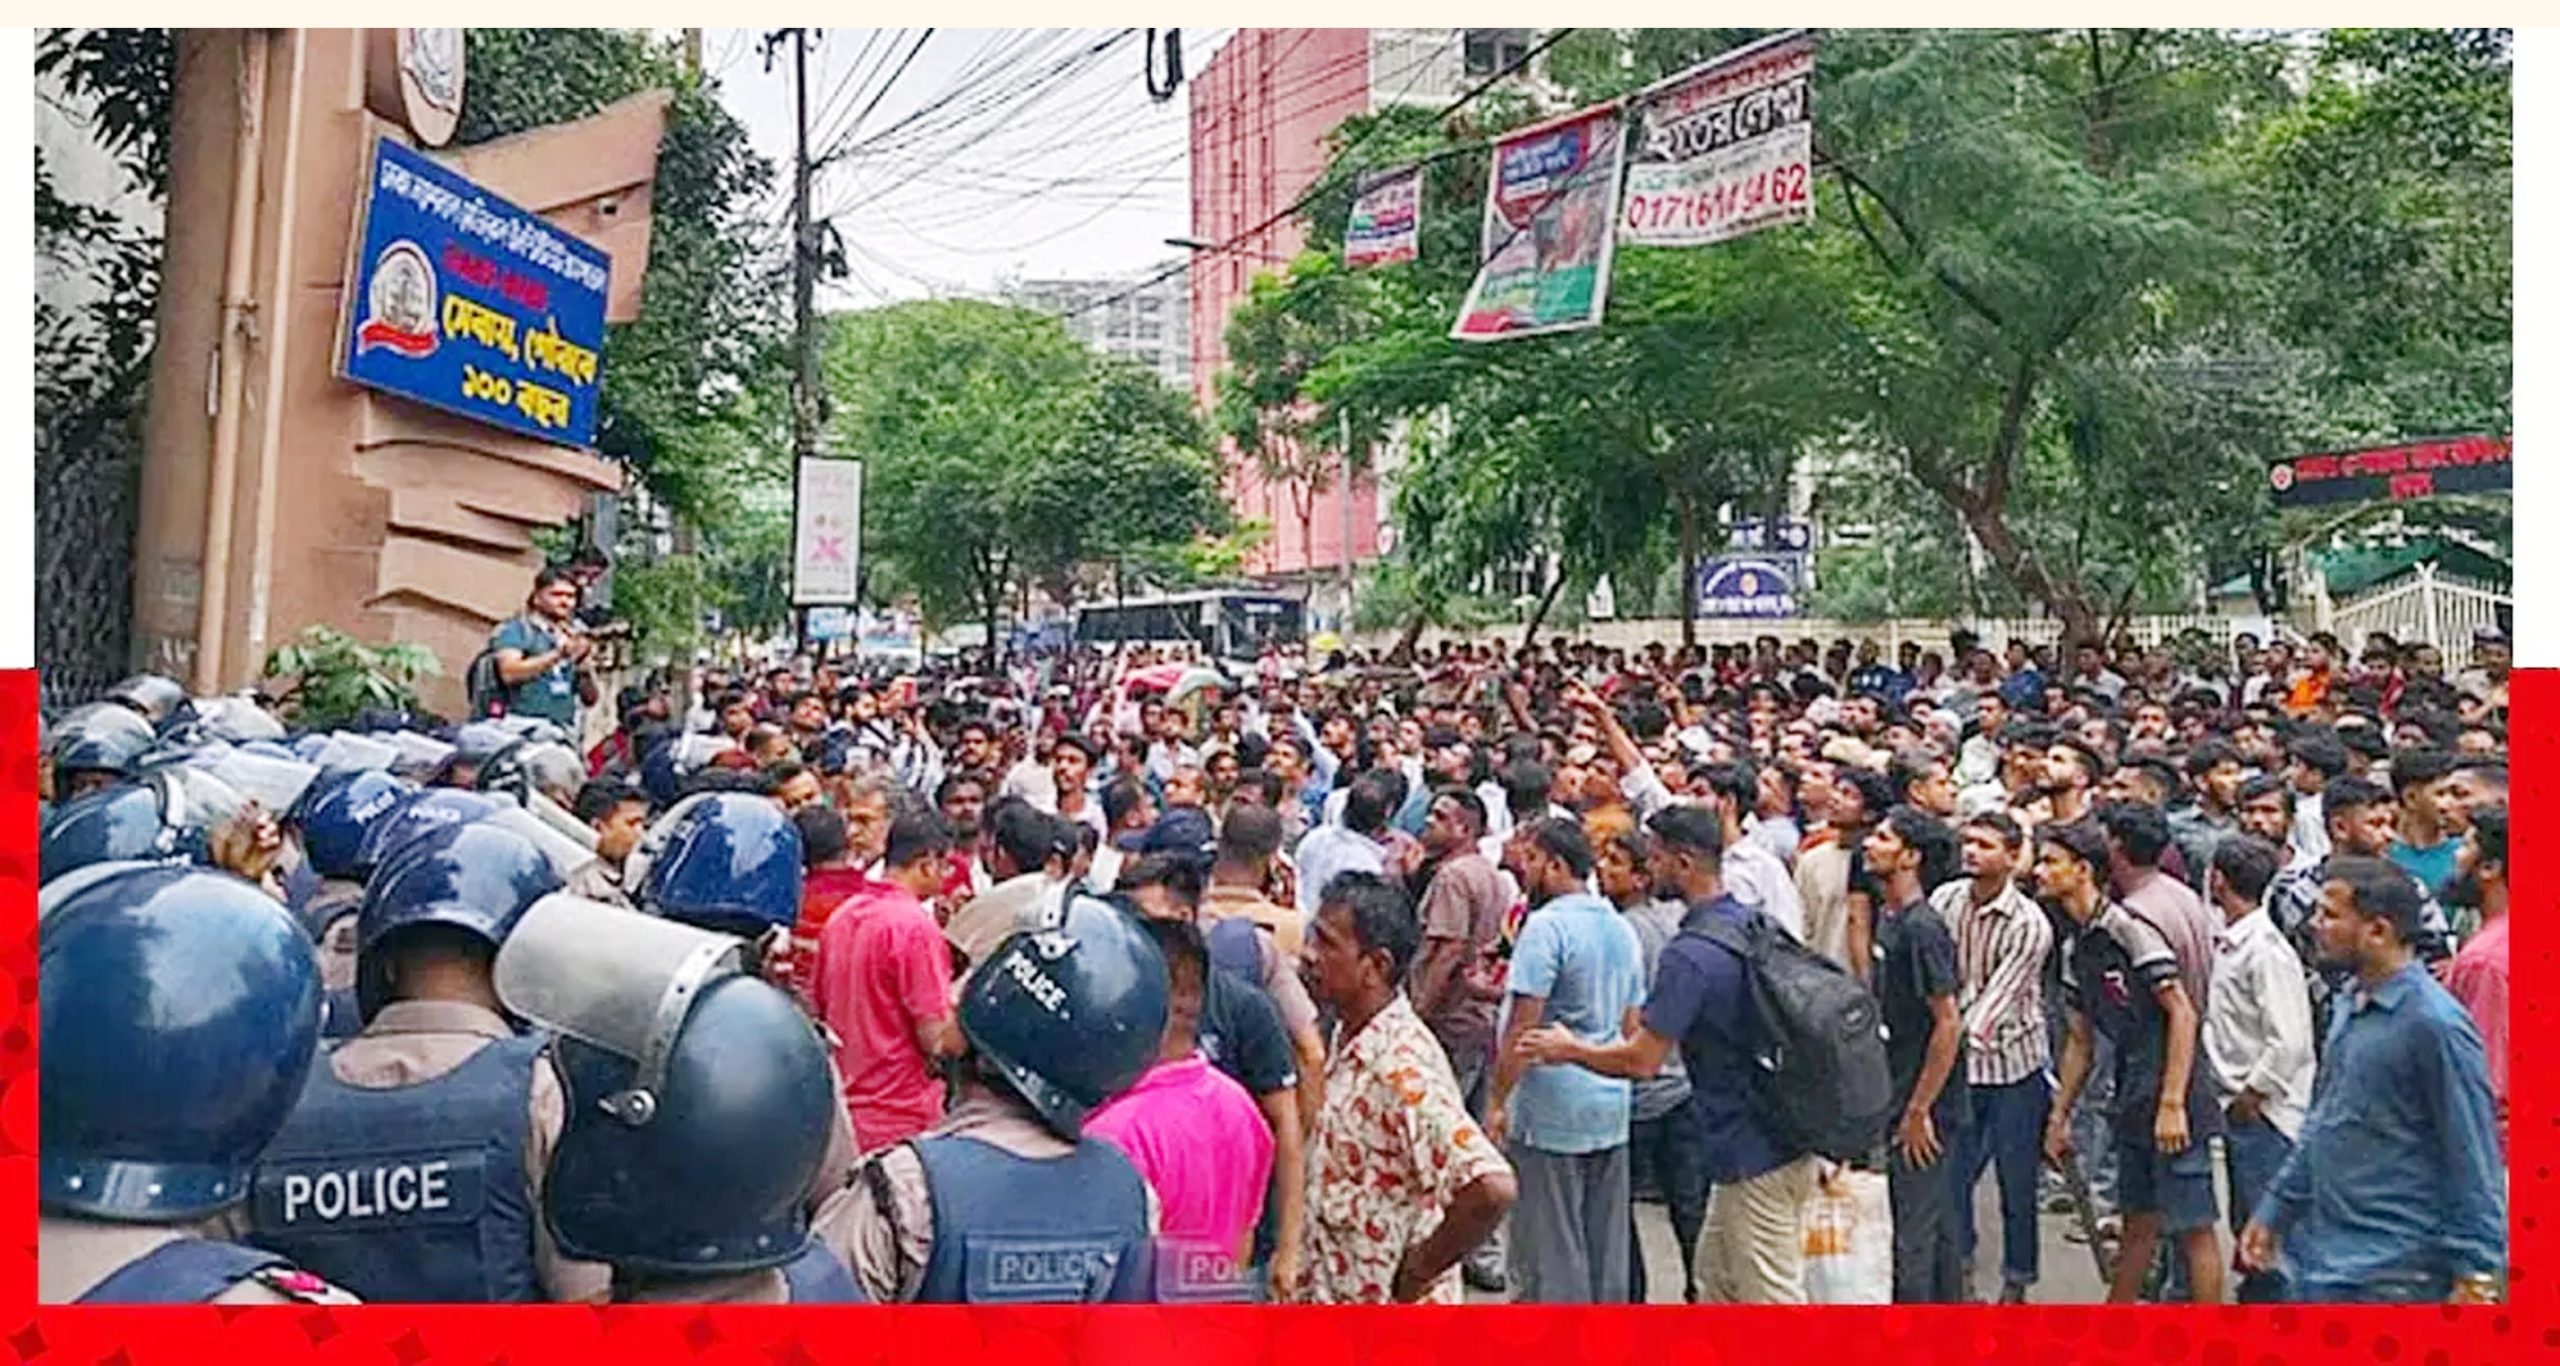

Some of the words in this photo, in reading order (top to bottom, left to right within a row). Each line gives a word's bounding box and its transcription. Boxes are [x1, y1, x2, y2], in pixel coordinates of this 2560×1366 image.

[462, 363, 512, 406] ১০০
[1004, 949, 1068, 1012] POLICE
[284, 1160, 450, 1222] POLICE
